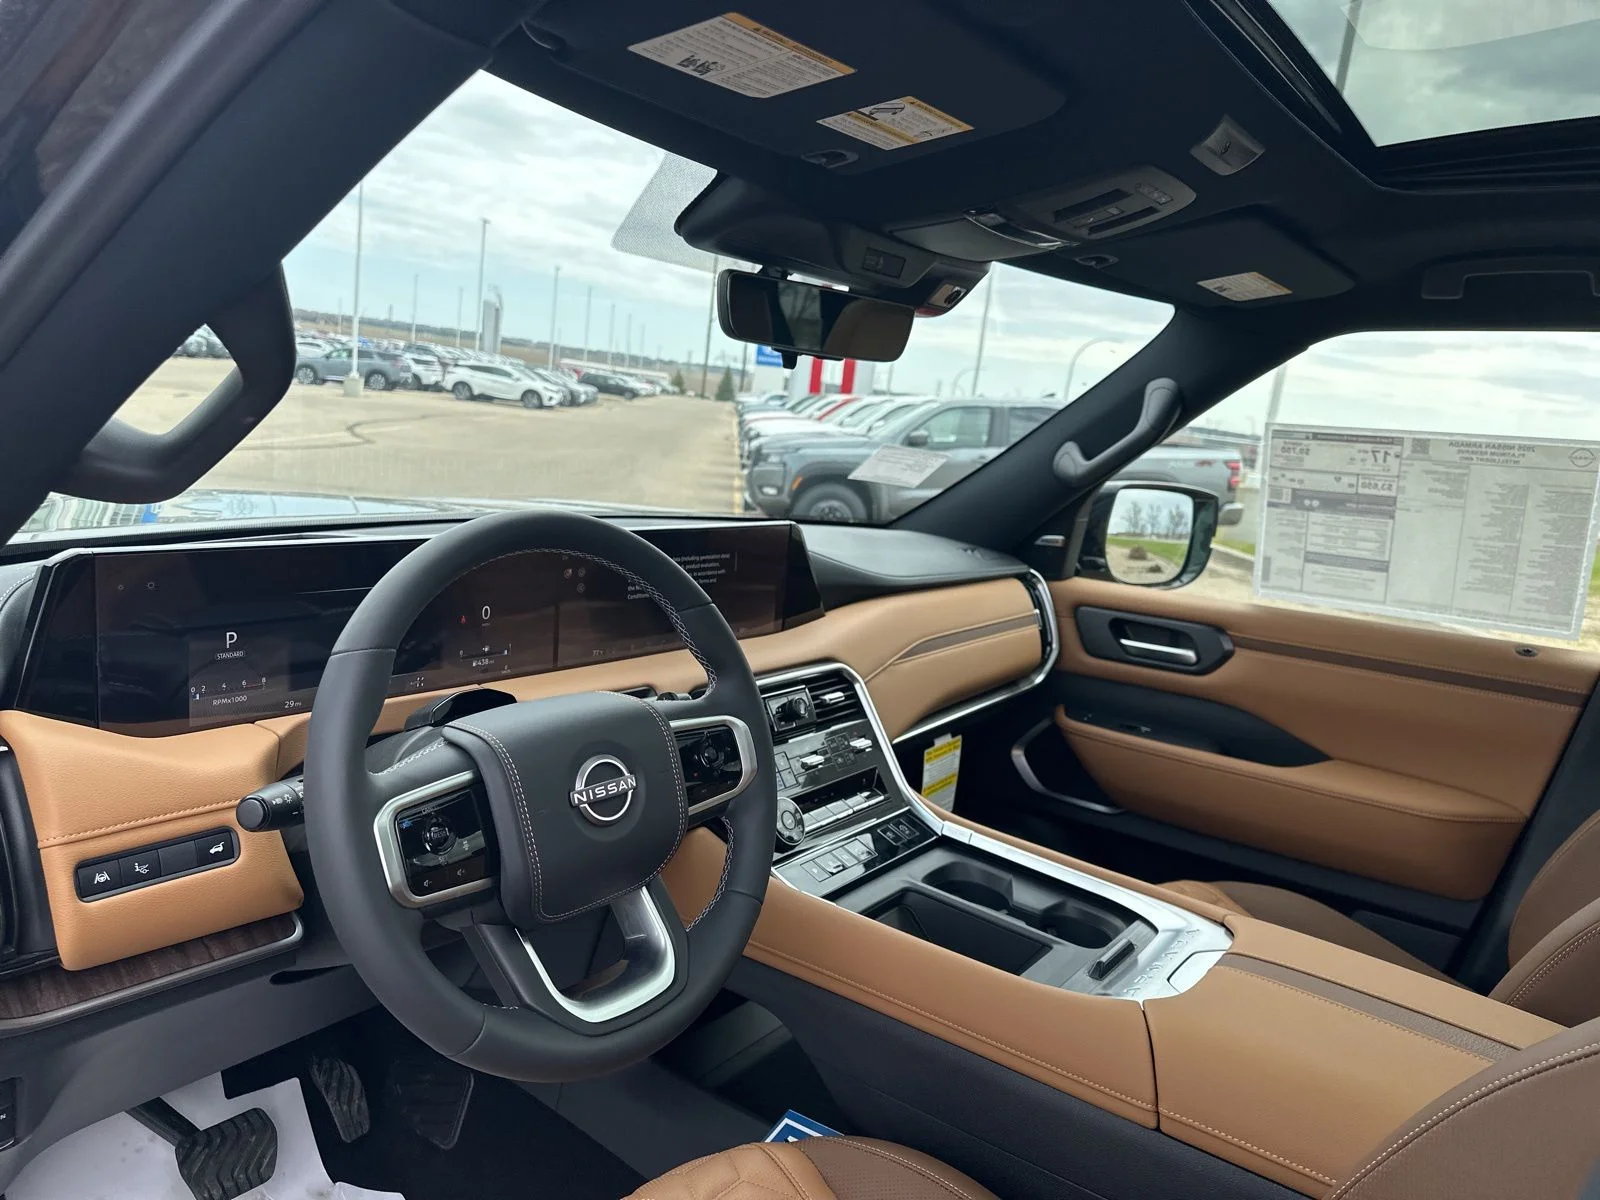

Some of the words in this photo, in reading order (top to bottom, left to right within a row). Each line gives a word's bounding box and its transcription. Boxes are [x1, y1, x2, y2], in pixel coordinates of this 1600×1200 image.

[482, 605, 491, 620] 0
[226, 631, 238, 649] P
[217, 651, 244, 660] STANDARD
[212, 696, 247, 706] RPMx1000
[573, 776, 637, 804] NISSAN
